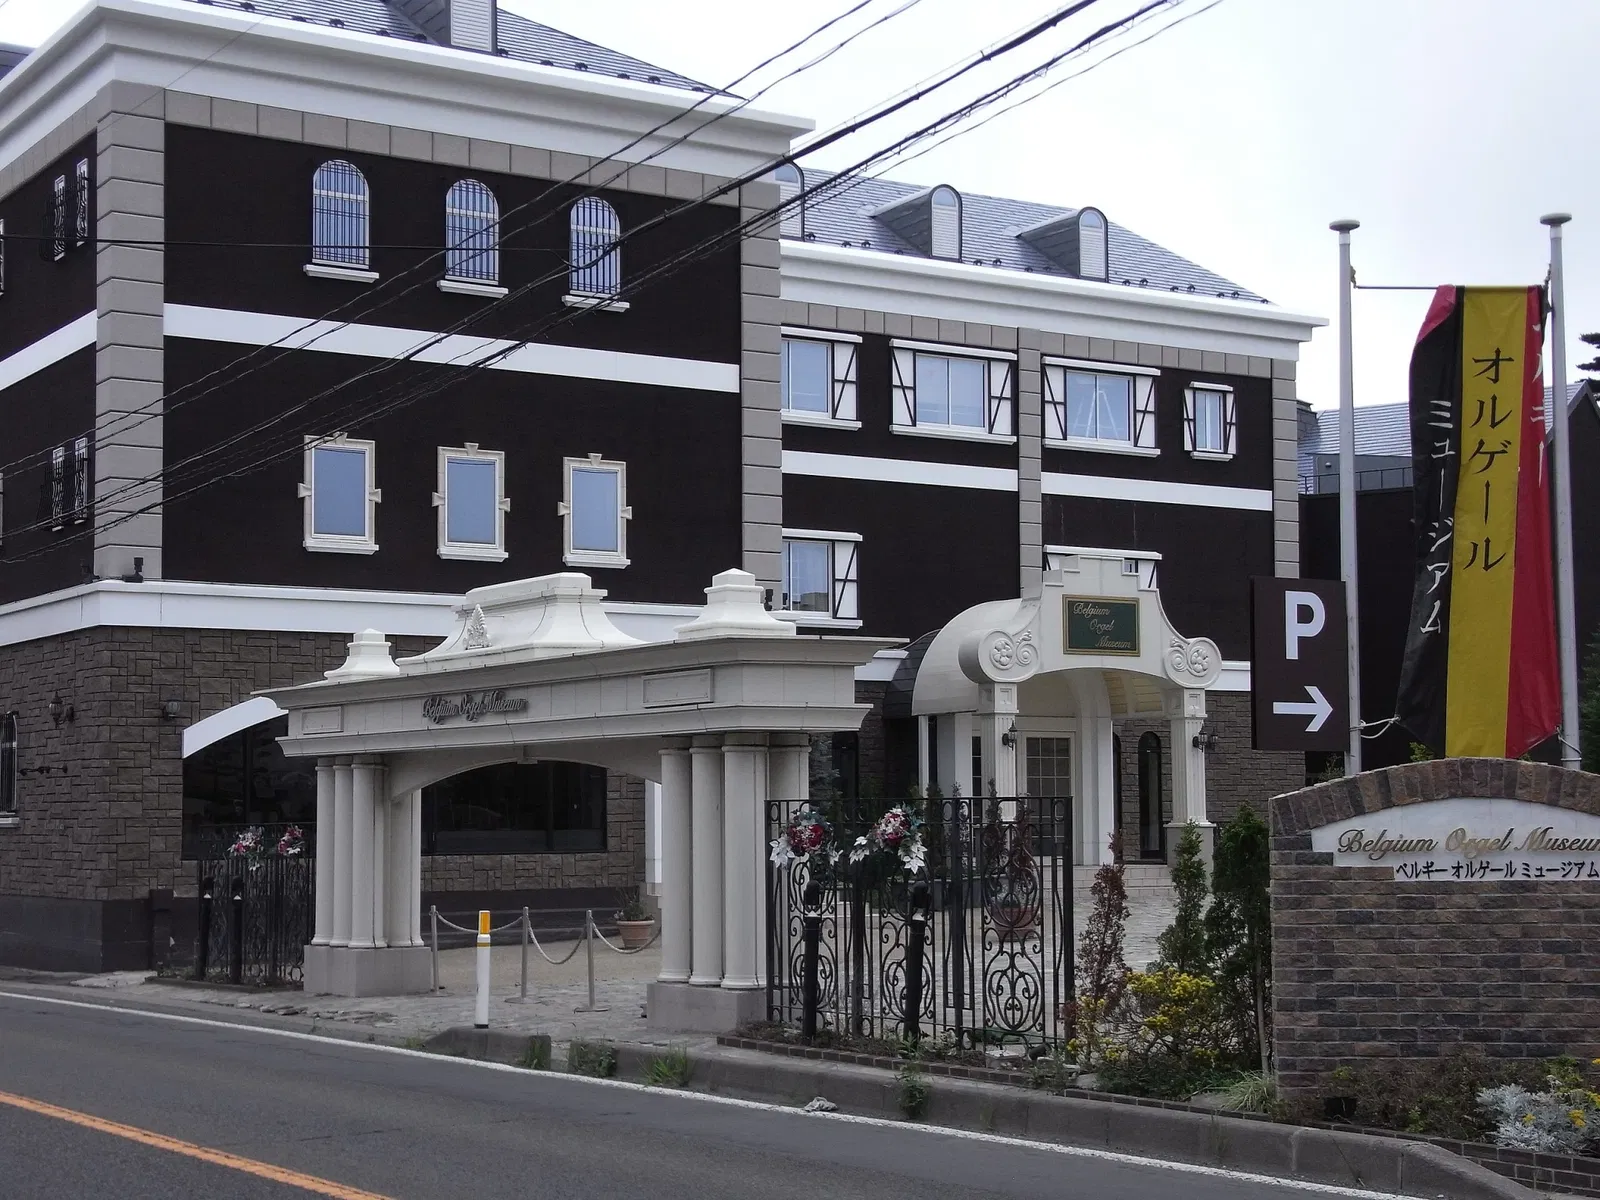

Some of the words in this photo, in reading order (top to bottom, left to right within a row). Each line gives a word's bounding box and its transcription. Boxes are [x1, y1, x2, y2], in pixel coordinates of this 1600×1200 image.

[1463, 347, 1515, 572] オルゲール
[1419, 400, 1455, 635] ミュージアム
[1073, 602, 1110, 618] Belgium
[1089, 618, 1115, 634] Orgel
[1285, 590, 1326, 660] P
[1095, 636, 1131, 649] Museum
[1337, 829, 1438, 861] Belgium
[1445, 827, 1514, 859] Orgel
[1513, 826, 1600, 852] Museu
